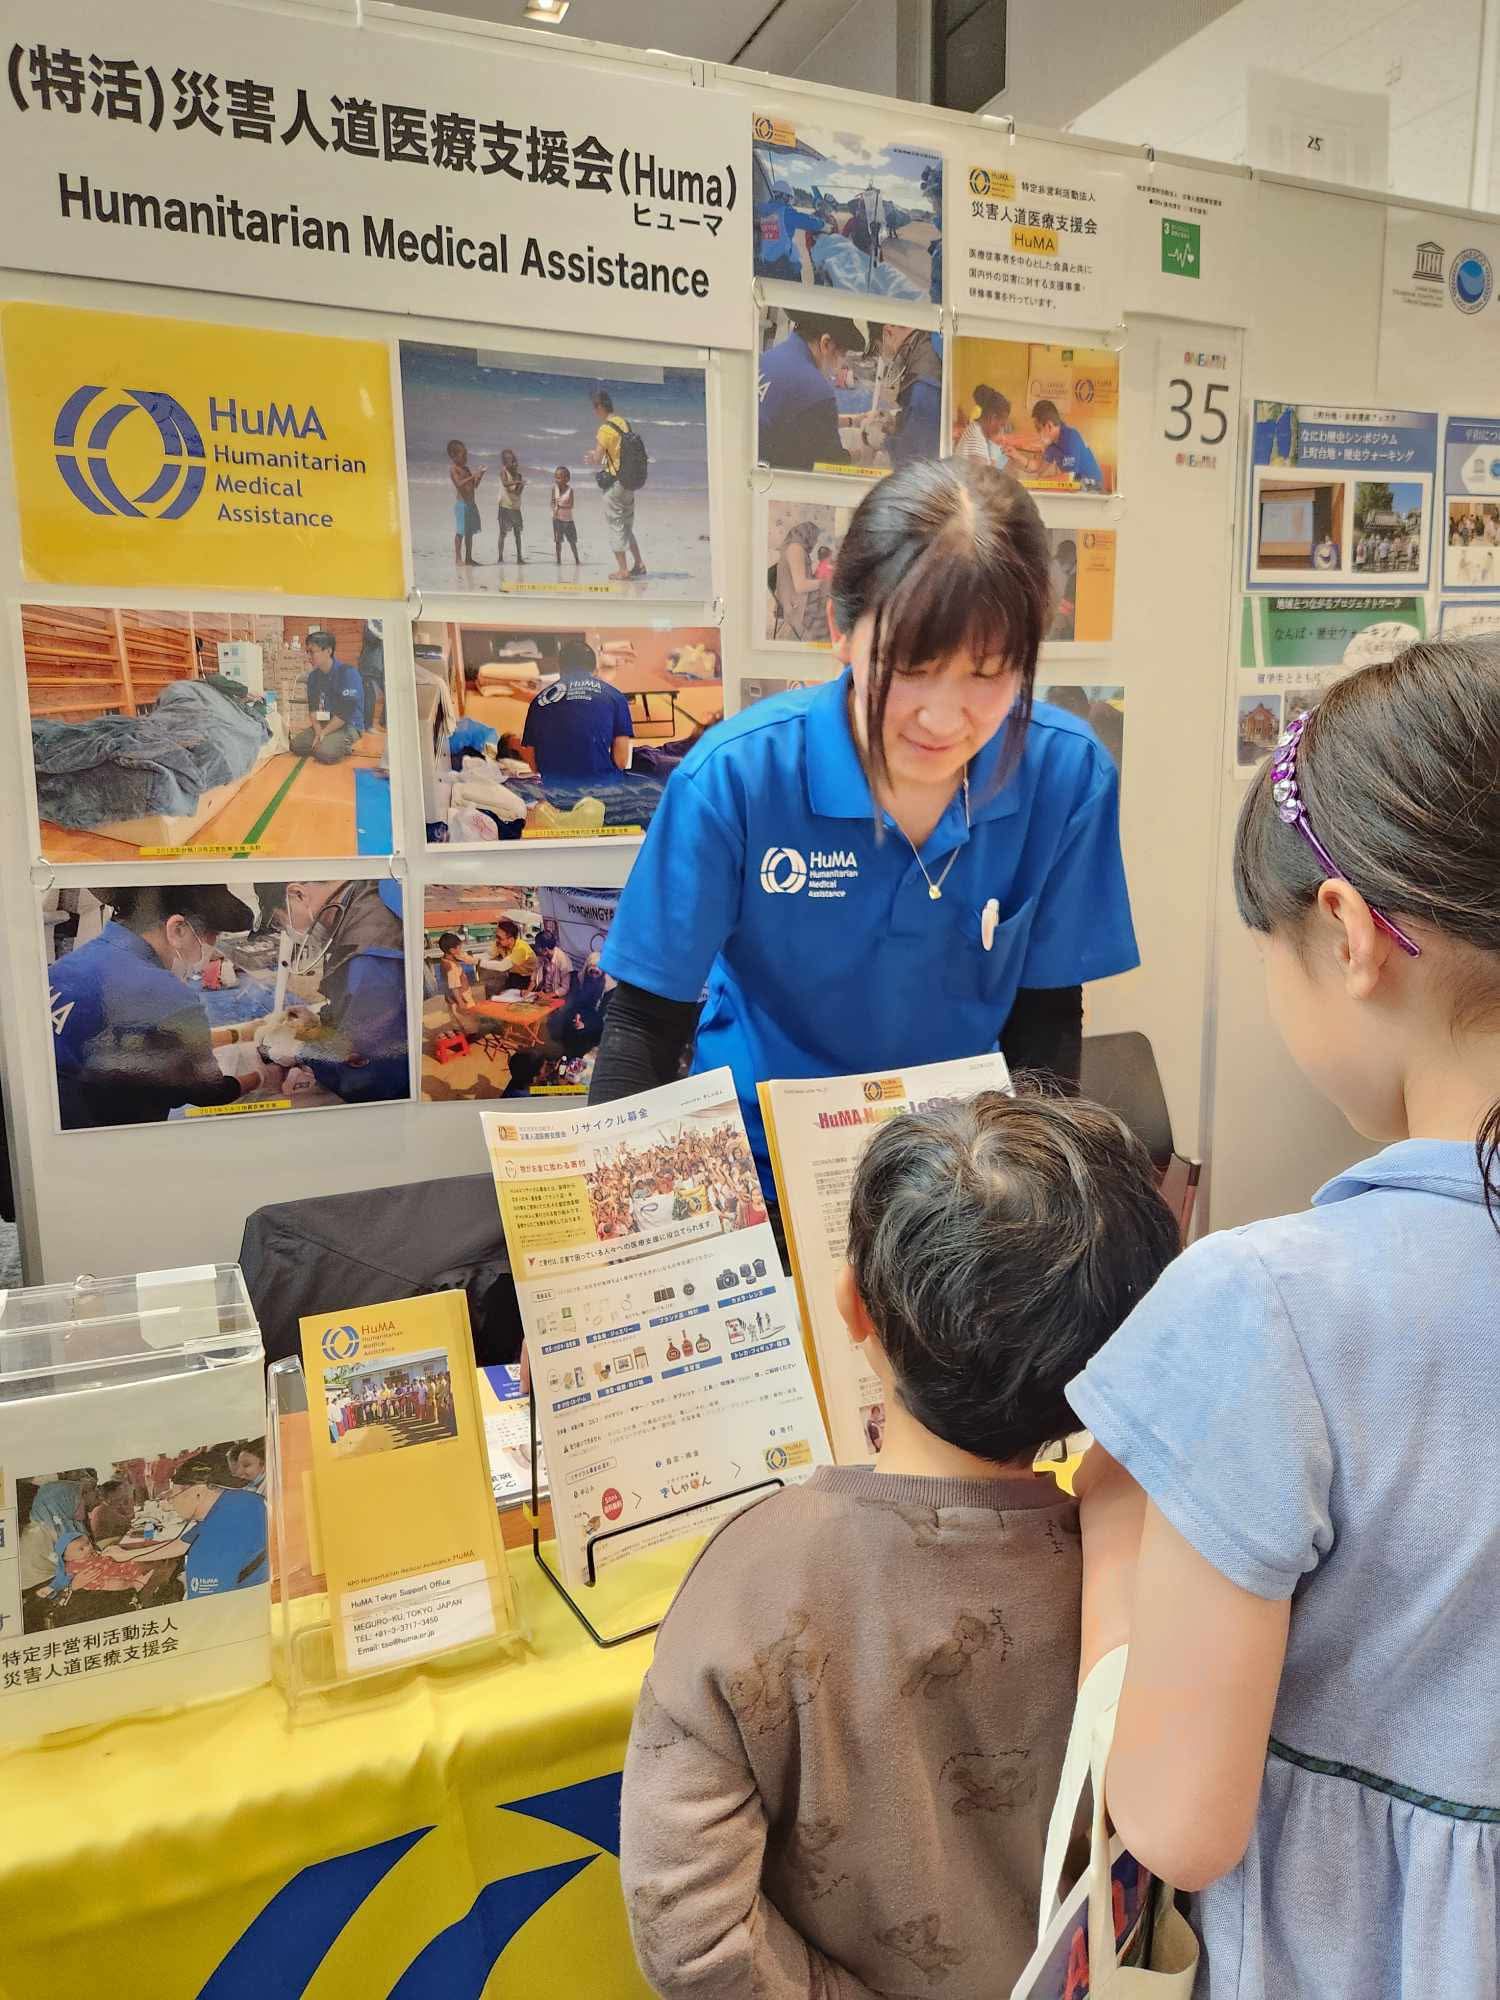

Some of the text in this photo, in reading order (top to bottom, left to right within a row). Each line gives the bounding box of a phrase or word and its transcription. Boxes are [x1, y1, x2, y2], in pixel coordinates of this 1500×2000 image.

[8, 43, 737, 211] (特活)災害人道医療支援会(Huma)
[633, 202, 723, 236] ヒューマ
[971, 199, 1098, 235] 災害人道医療支援会
[58, 172, 711, 298] Humanitarian Medical Assistance
[1013, 231, 1056, 252] HuMA
[208, 396, 328, 441] HuMA
[1163, 378, 1229, 445] 35
[213, 444, 367, 474] Humanitarian
[215, 474, 304, 498] Medical
[217, 503, 334, 528] Assistance
[809, 851, 858, 869] HuMA
[809, 869, 859, 879] Humanitarian
[808, 879, 837, 889] Medical
[571, 1107, 649, 1135] リサイクル募金
[361, 1320, 396, 1335] HuMA
[351, 1577, 451, 1609] HuMA Tokyo Support Office
[406, 1606, 433, 1619] TOKYO
[436, 1598, 463, 1611] JAPAN
[2, 1616, 178, 1669] 特定非営利活動法人
[3, 1635, 180, 1689] 災害人道医療支援会
